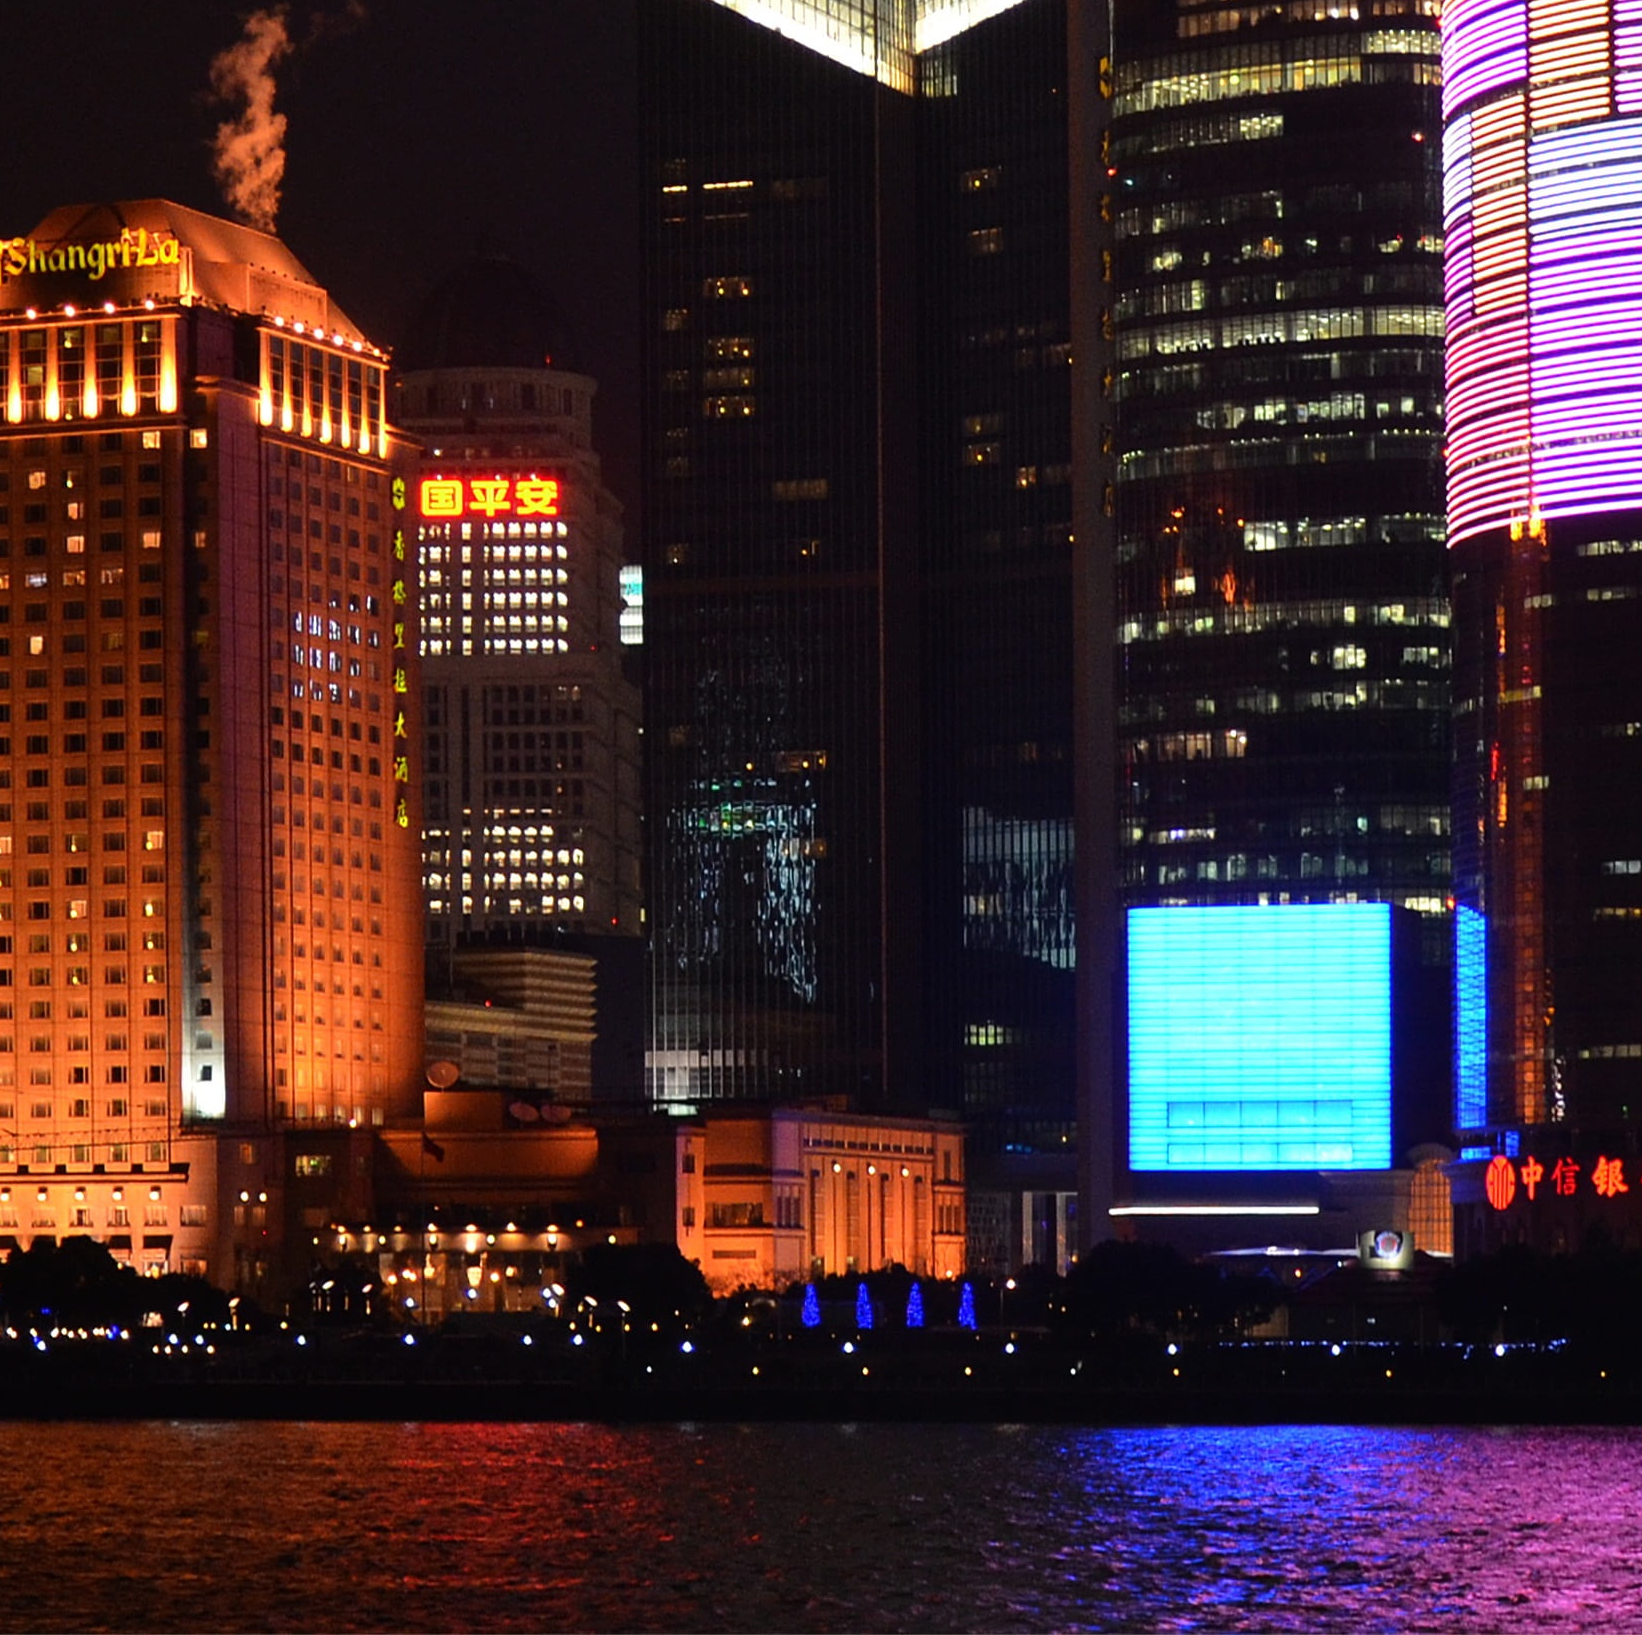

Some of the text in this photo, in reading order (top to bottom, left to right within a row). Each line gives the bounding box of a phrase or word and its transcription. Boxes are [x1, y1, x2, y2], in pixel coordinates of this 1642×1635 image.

[5, 227, 179, 280] Shangri-La
[420, 478, 559, 518] 国平安
